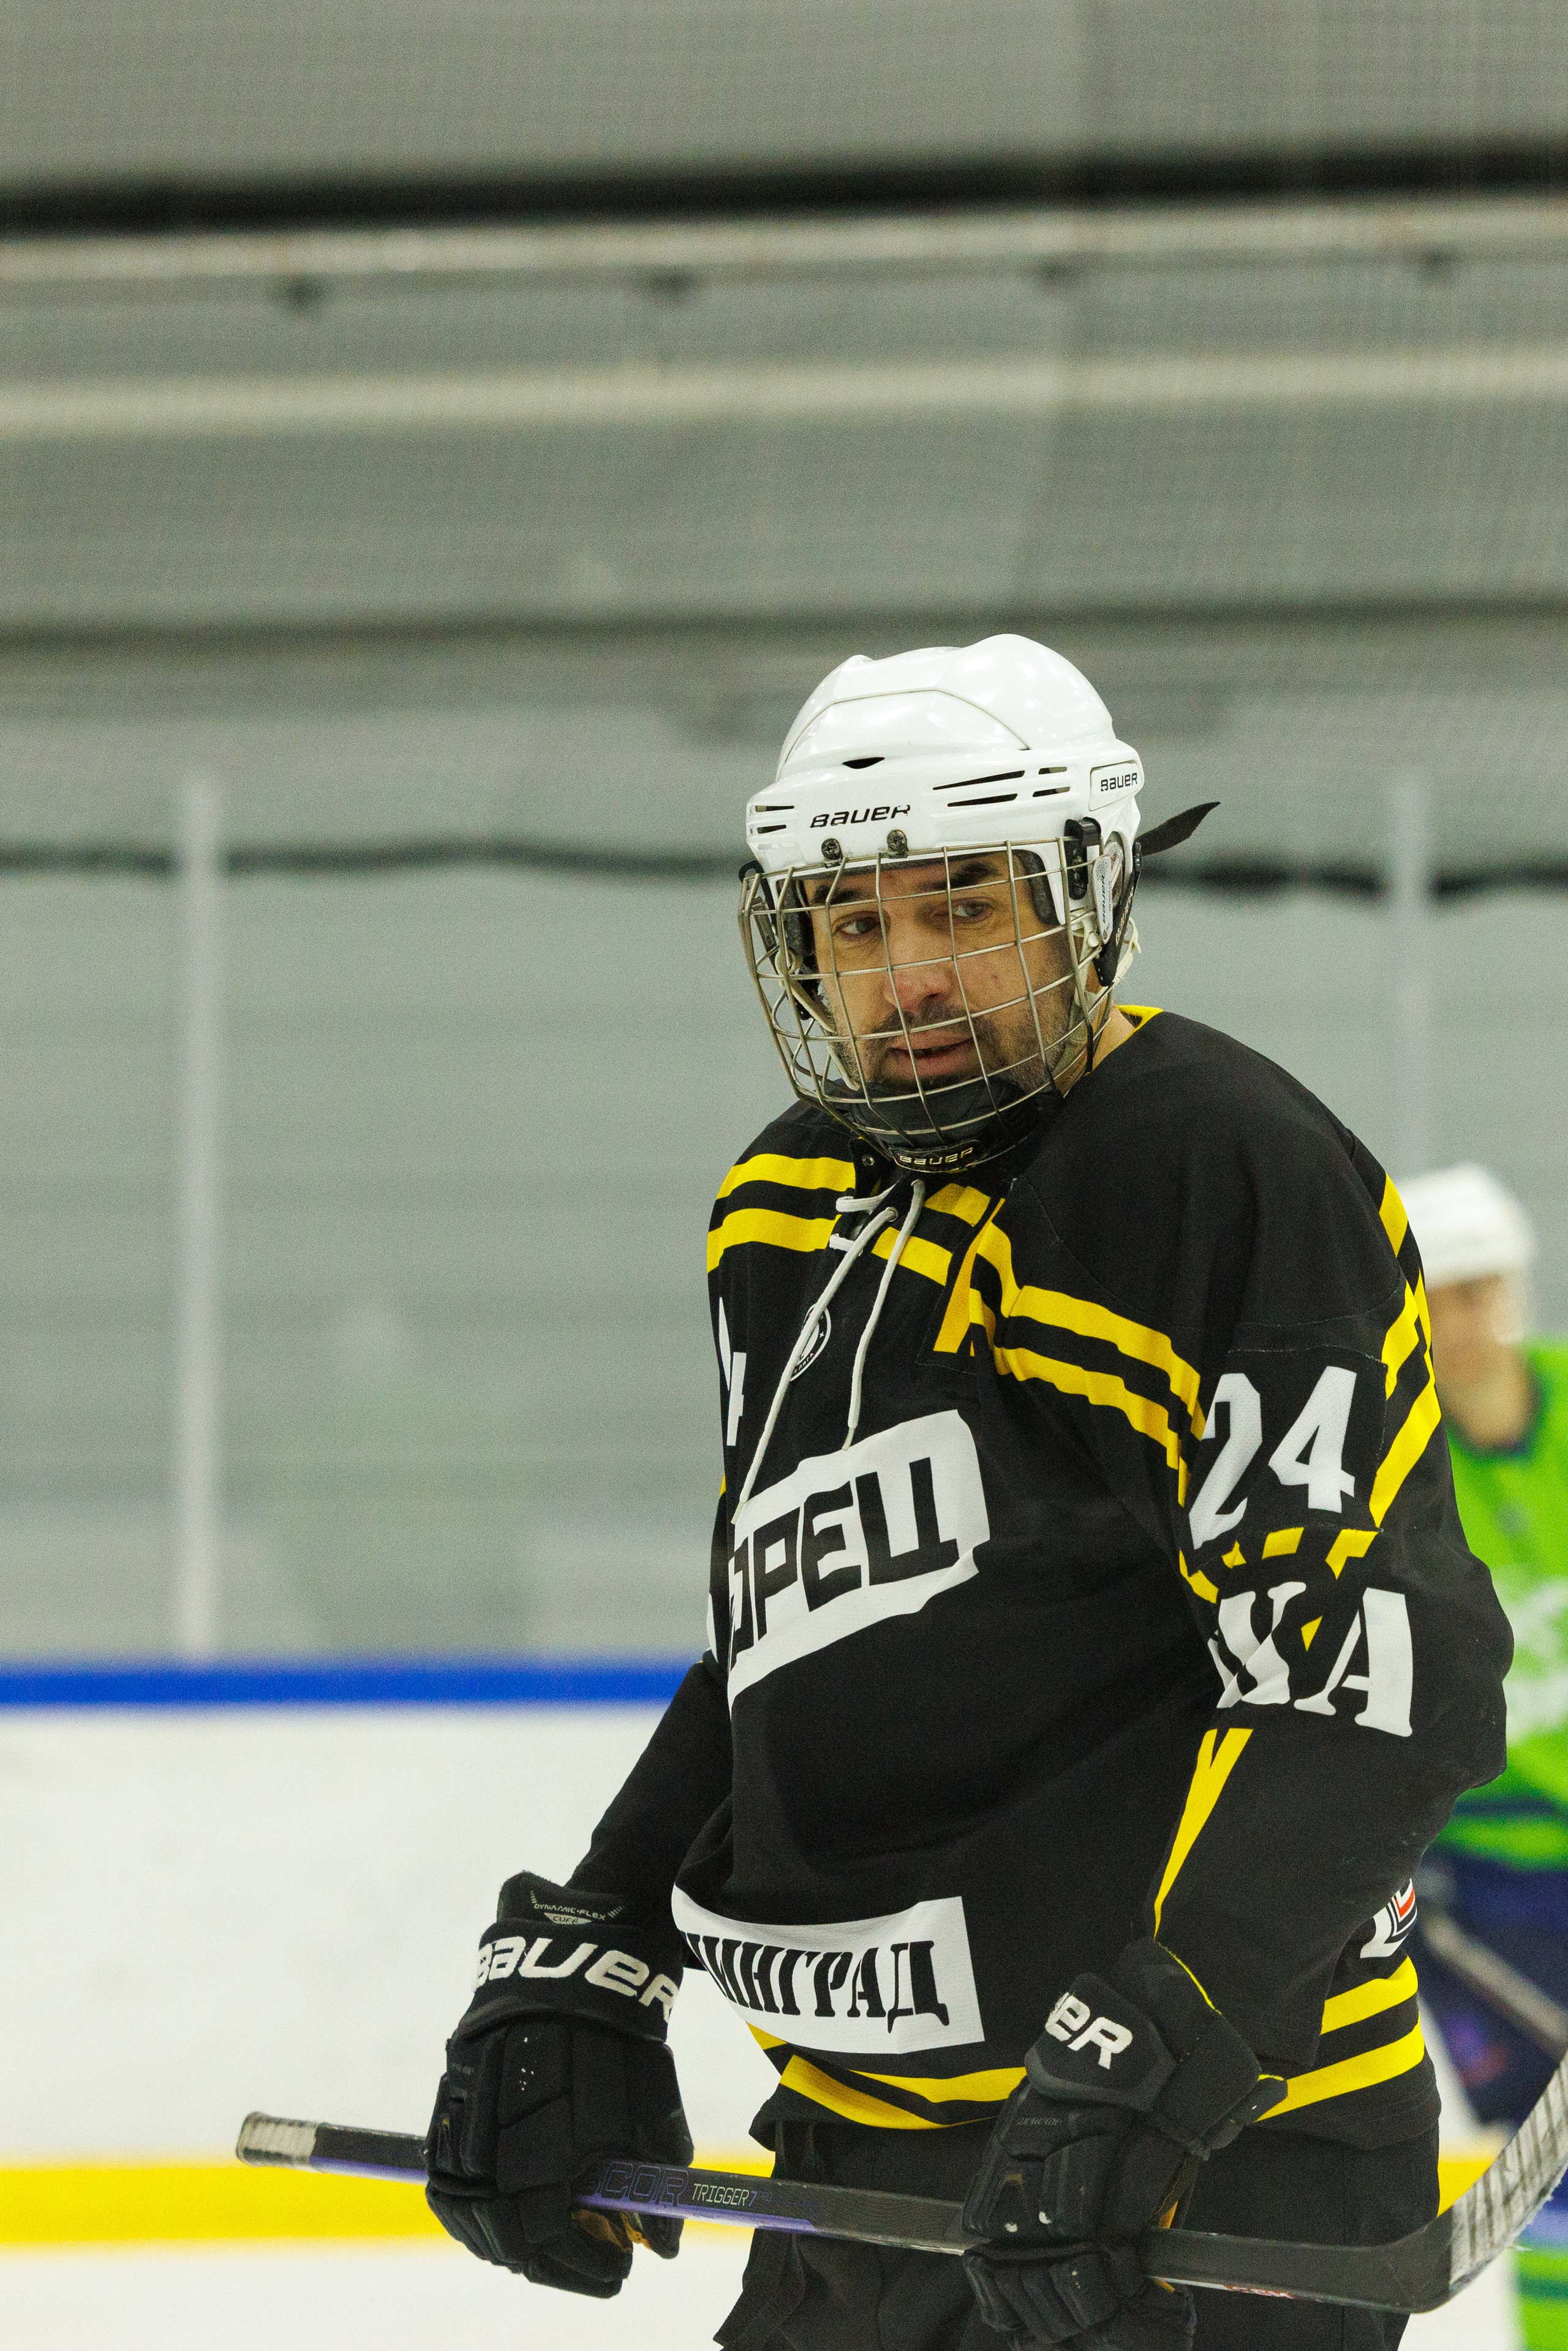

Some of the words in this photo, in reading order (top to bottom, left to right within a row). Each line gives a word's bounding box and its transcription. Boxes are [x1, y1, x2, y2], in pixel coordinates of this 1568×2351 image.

[1188, 1366, 1357, 1550] 24
[1208, 1581, 1413, 1738] КА
[682, 1931, 949, 2034] ИНГРАД
